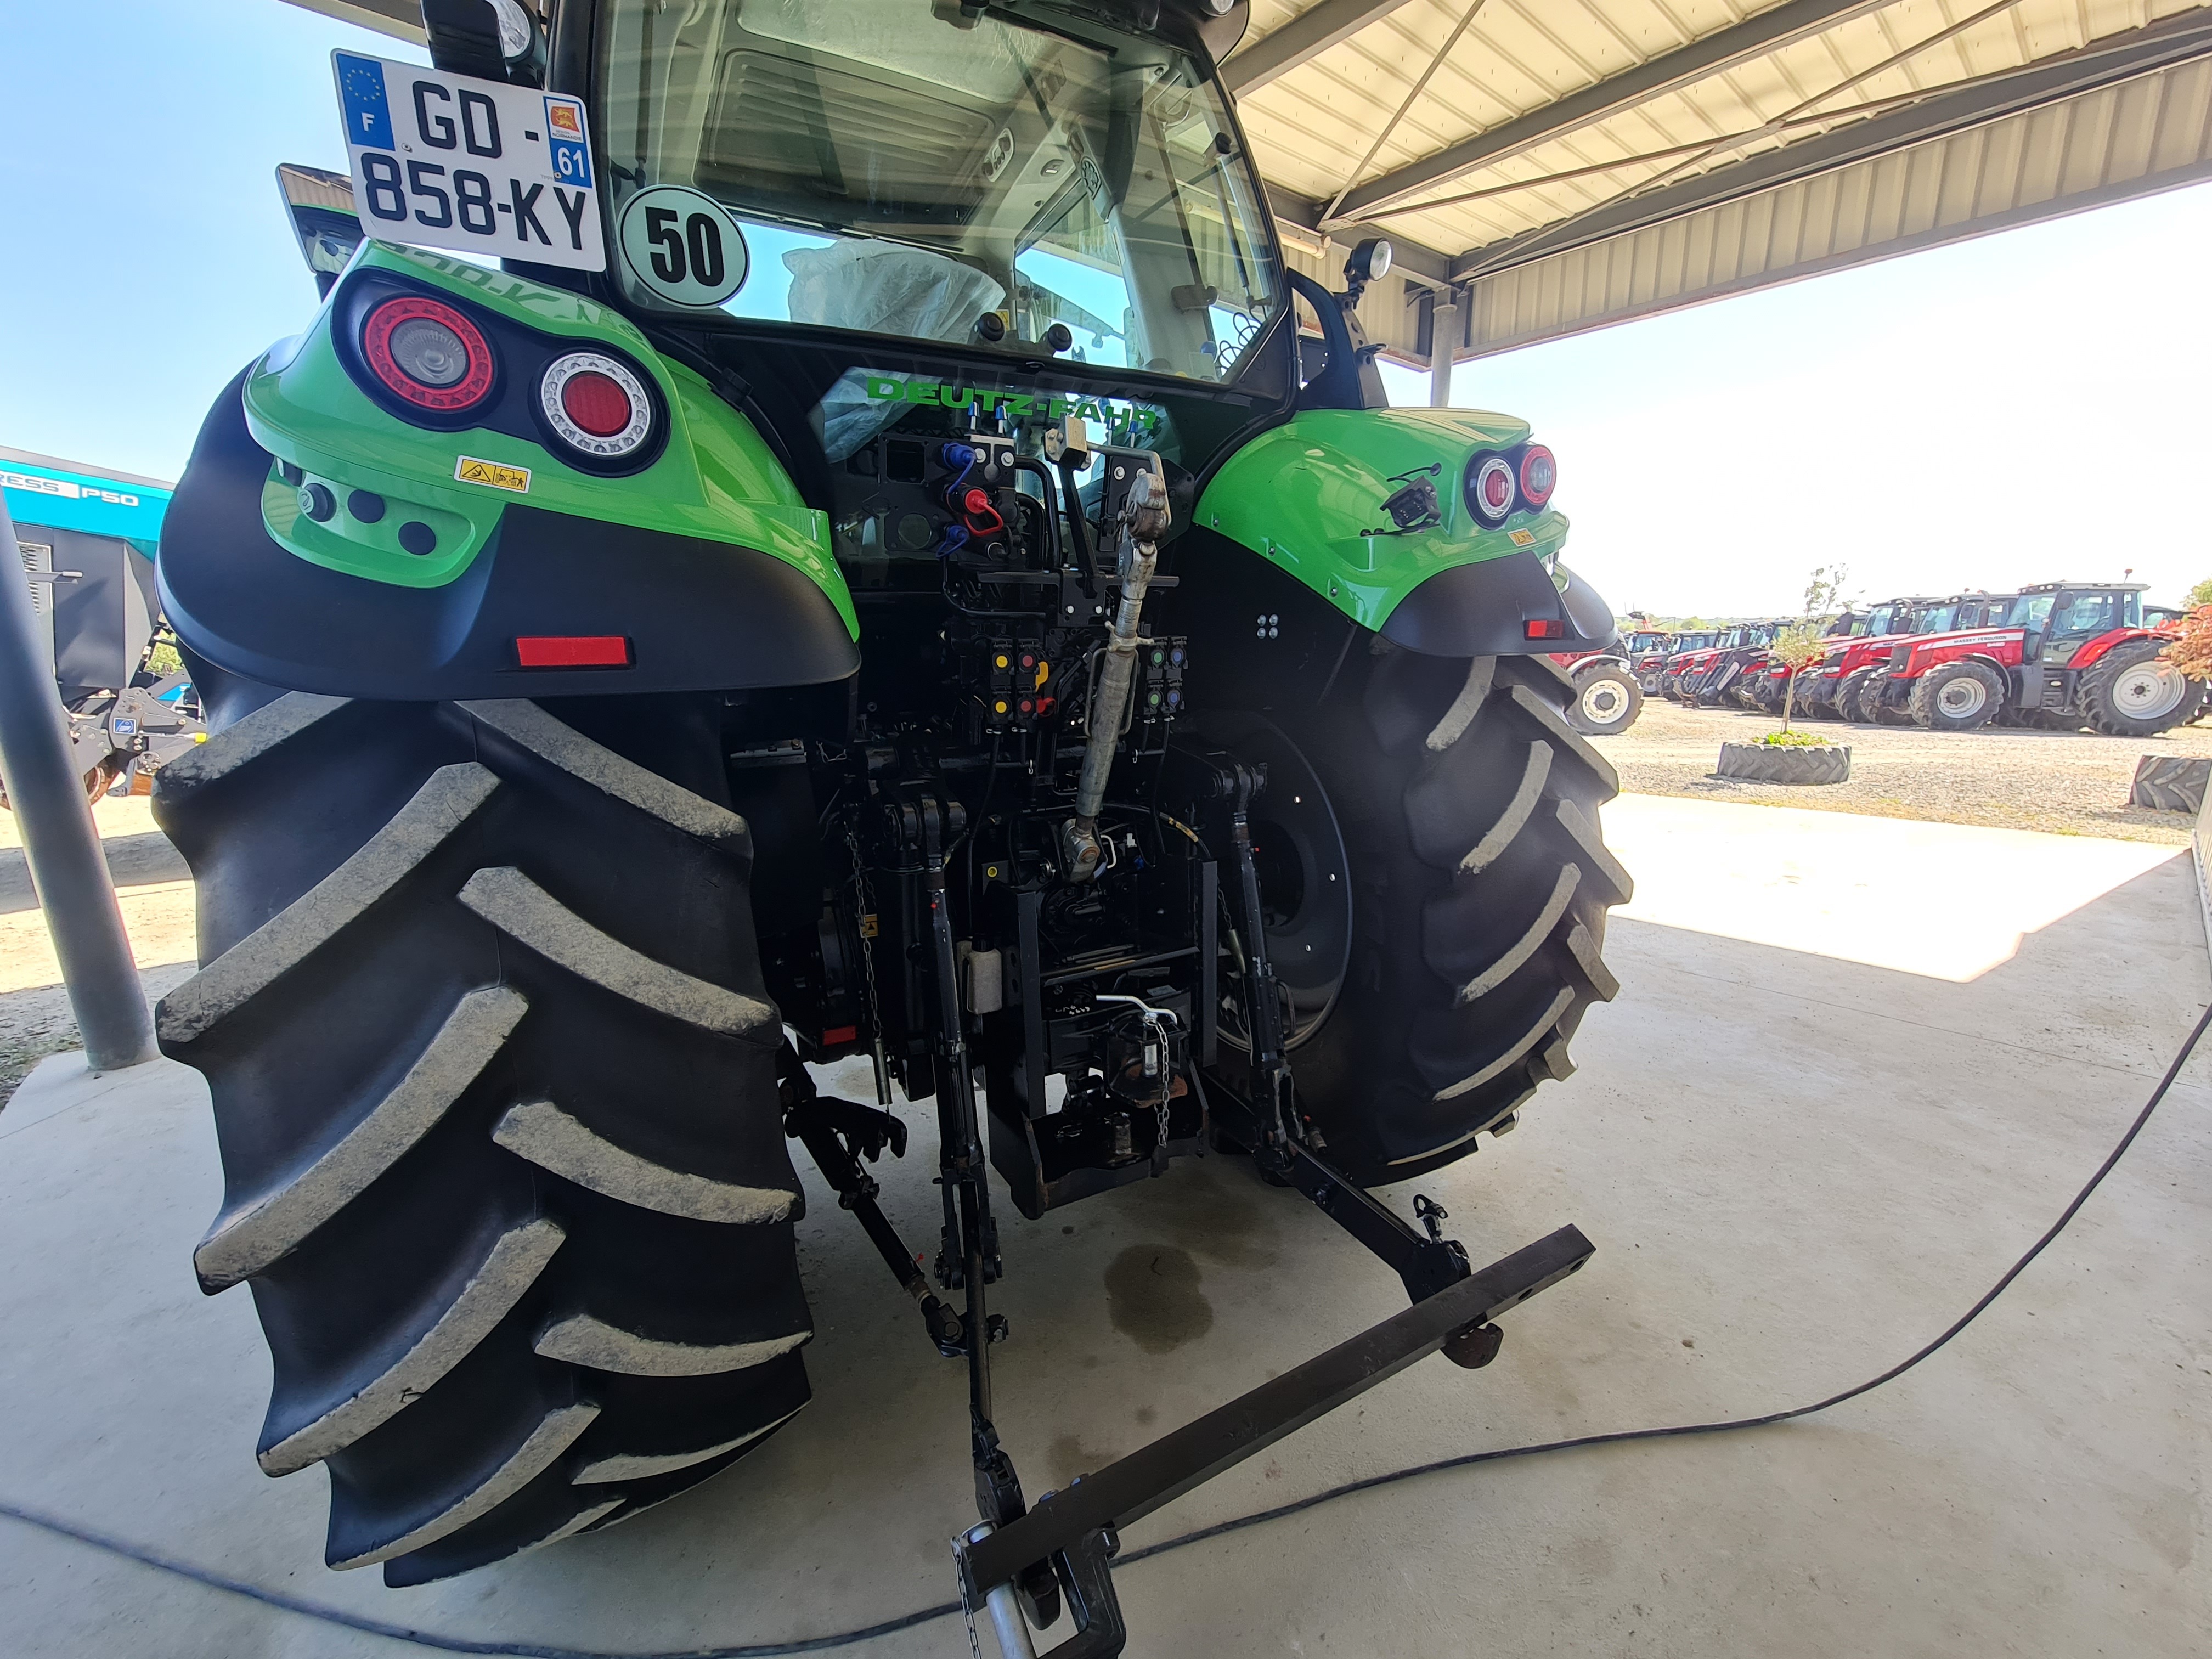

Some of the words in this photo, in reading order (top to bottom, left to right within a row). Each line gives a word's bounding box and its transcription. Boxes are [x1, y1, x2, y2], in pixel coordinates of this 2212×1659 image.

[361, 112, 375, 132] F
[557, 146, 585, 178] 61
[360, 152, 586, 250] 858-KY
[645, 206, 725, 287] 50
[867, 376, 1156, 430] DEUTZ-FAHR
